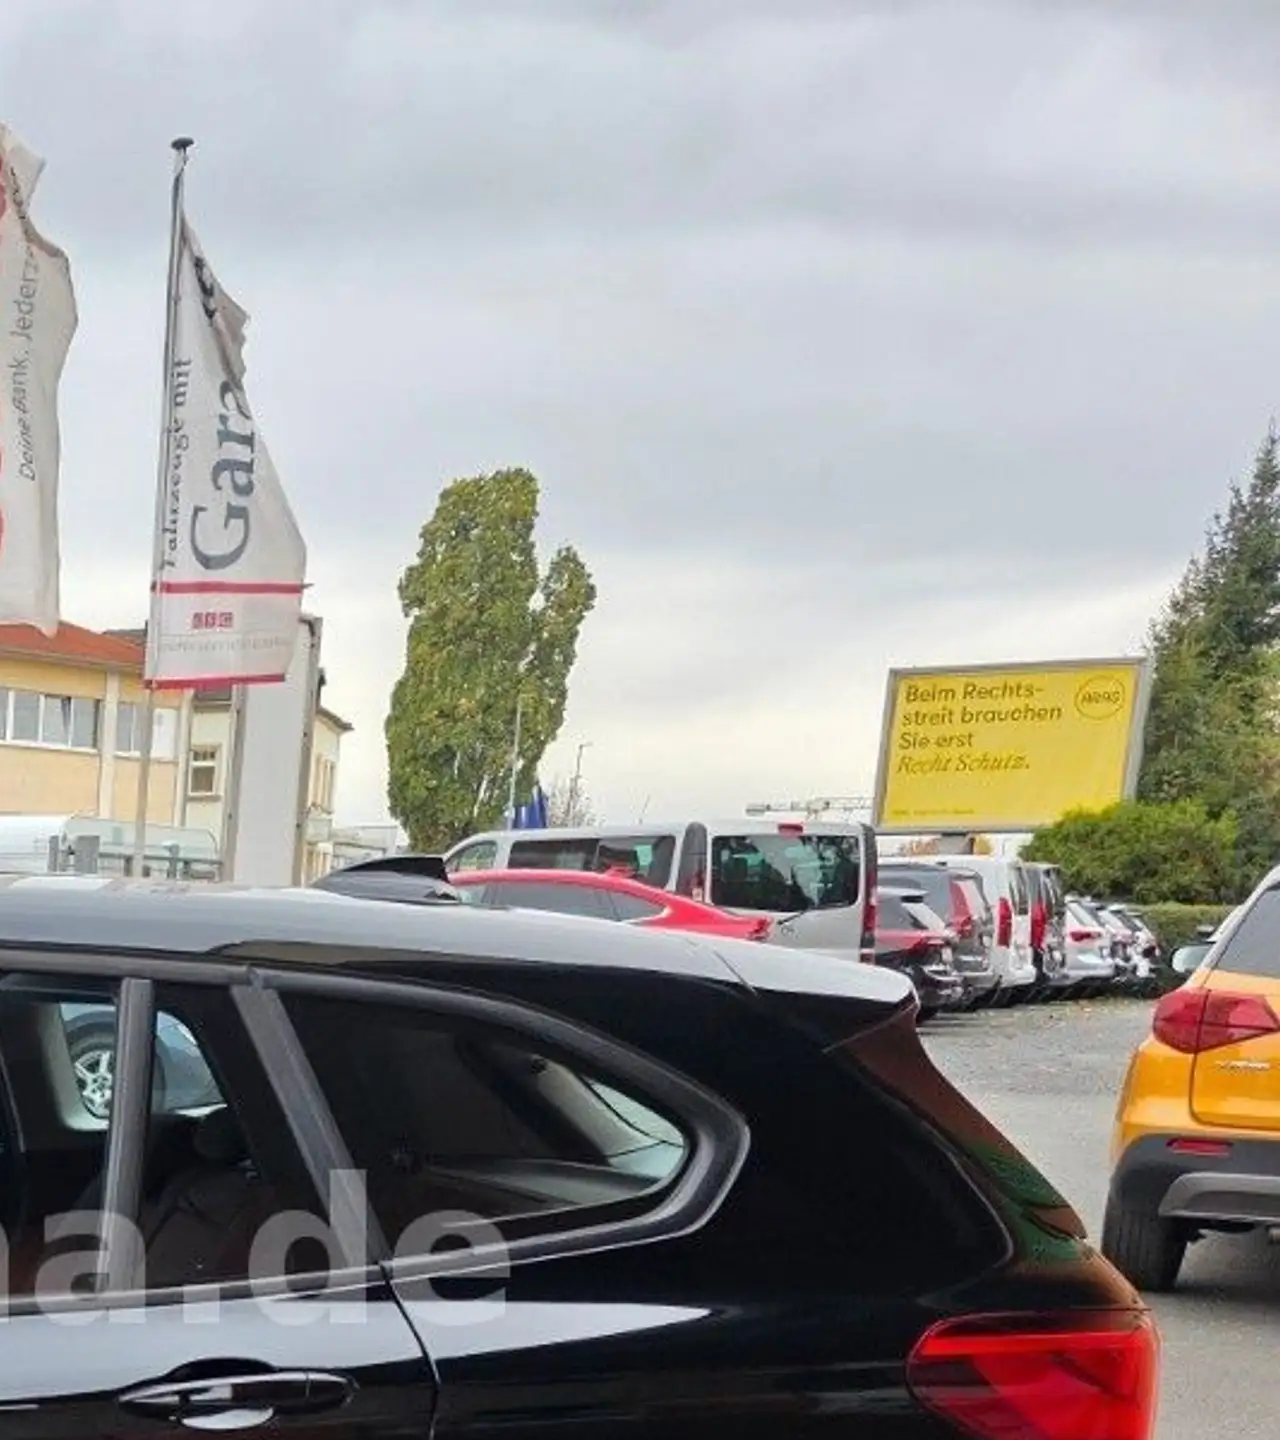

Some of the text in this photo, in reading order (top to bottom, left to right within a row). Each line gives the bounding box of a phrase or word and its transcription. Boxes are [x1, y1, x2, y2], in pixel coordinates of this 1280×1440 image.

[171, 357, 191, 407] mit
[905, 681, 1044, 704] Beim Rechts-
[902, 704, 1062, 727] streit brauchen
[898, 732, 974, 749] Sie erst
